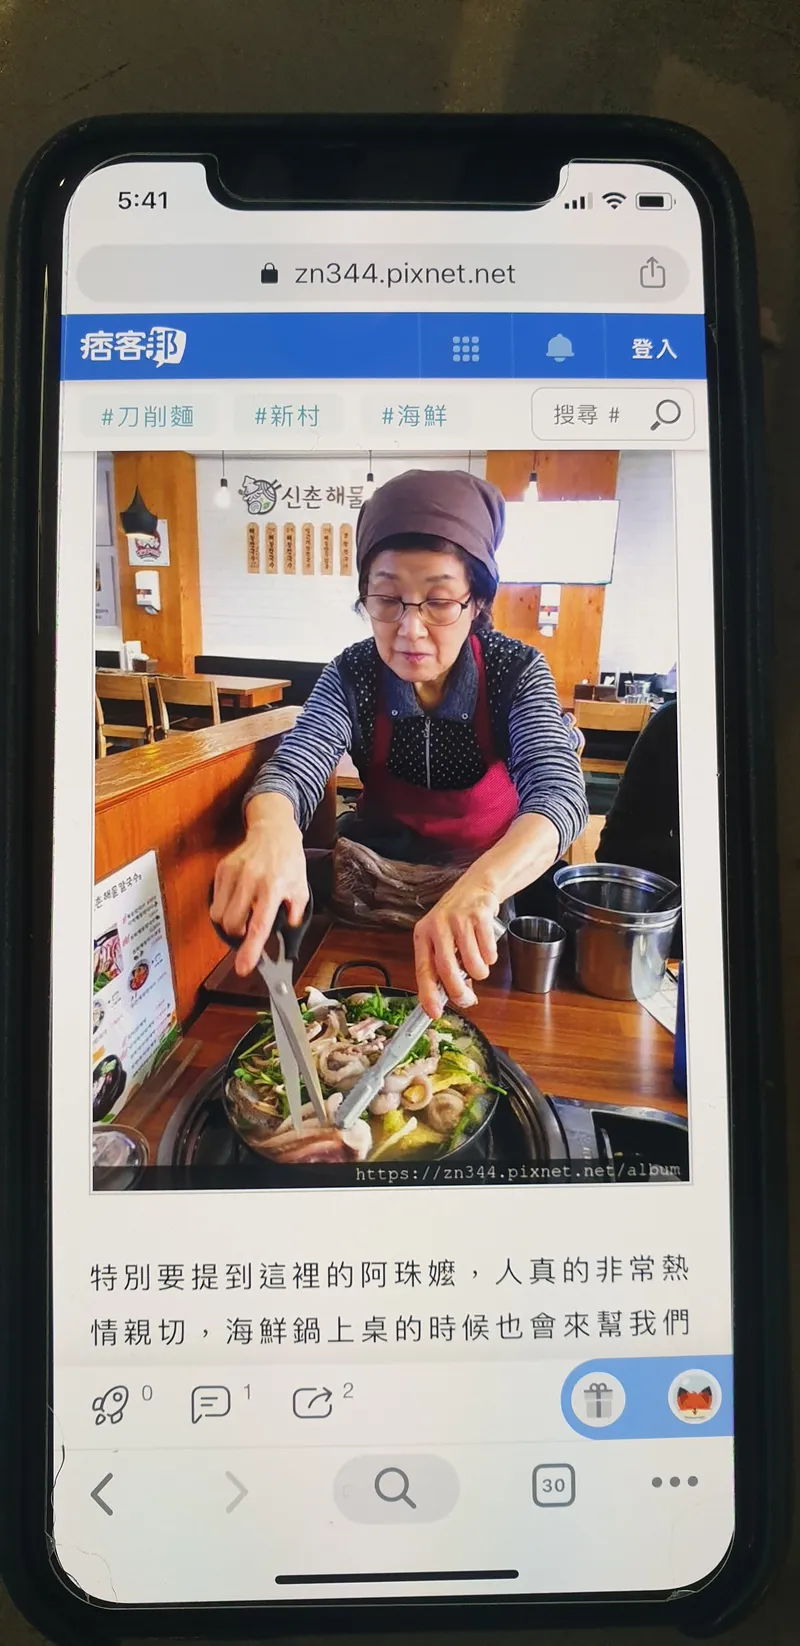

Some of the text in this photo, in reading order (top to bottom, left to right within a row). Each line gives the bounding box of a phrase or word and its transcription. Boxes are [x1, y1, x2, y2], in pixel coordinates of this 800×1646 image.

[118, 191, 168, 209] 5:41
[294, 262, 516, 288] zn344.pixnet.net
[80, 326, 187, 368] 痞客邦
[631, 338, 678, 360] 登入
[101, 405, 194, 428] #刀削麵
[254, 404, 320, 427] #新村
[381, 404, 448, 427] #海鮮
[553, 404, 599, 425] 搜尋
[355, 1162, 681, 1183] https://zn344.pixnet.net/album
[141, 1384, 153, 1402] 0
[243, 1383, 252, 1400] 1
[342, 1382, 354, 1399] 2
[542, 1478, 566, 1493] 30
